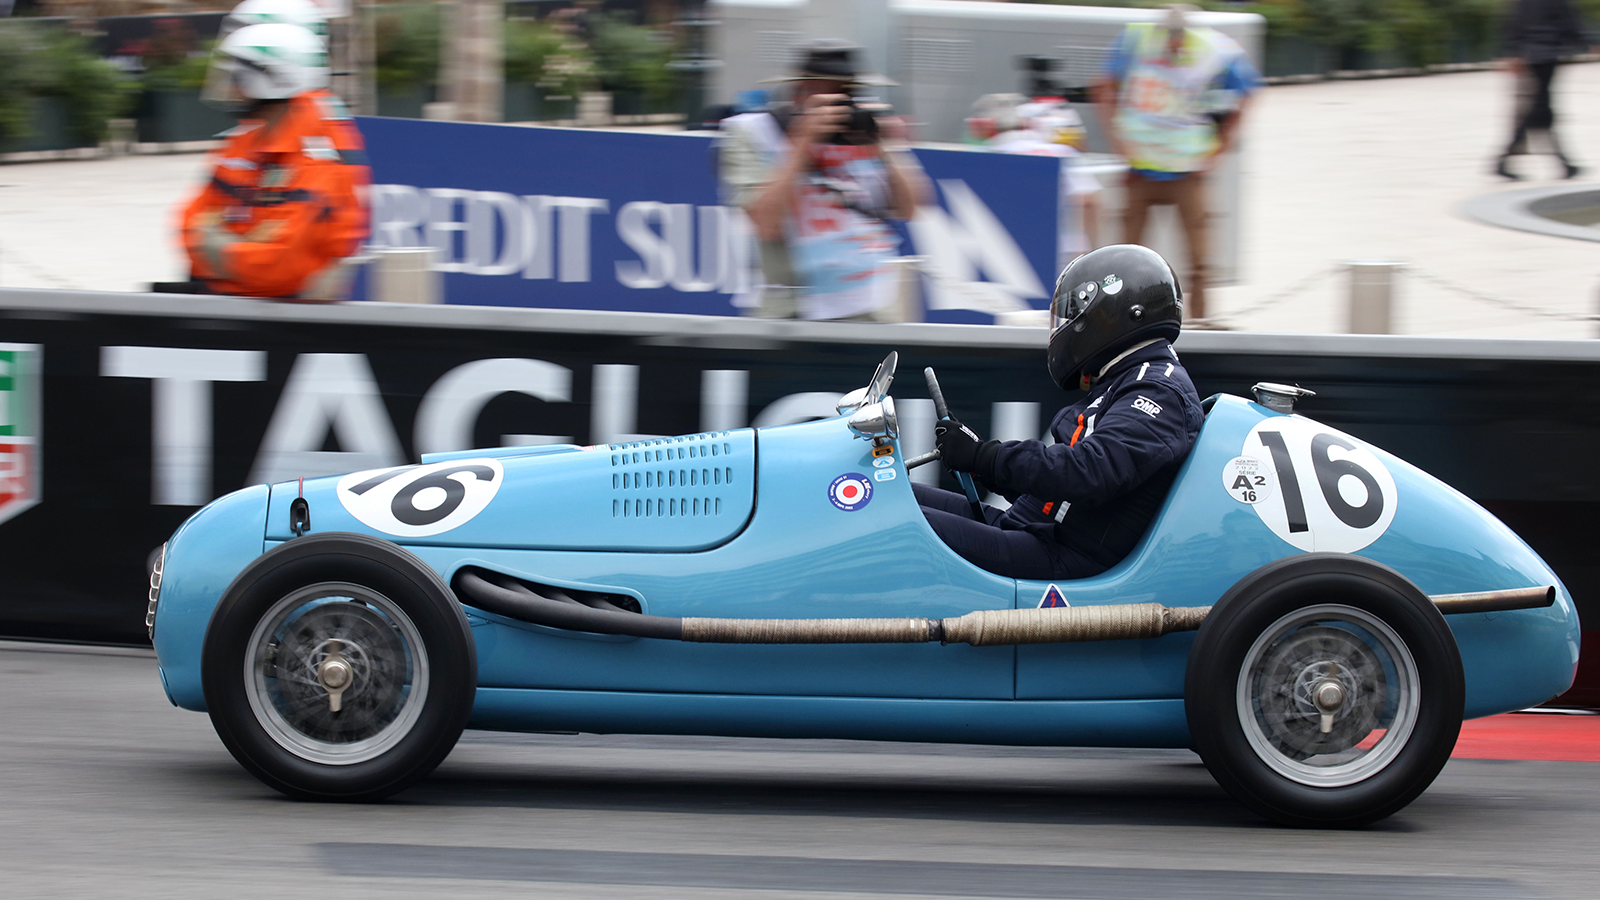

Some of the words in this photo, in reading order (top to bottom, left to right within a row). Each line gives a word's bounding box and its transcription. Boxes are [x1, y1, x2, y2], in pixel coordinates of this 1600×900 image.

[354, 184, 610, 284] REDIT
[1133, 398, 1161, 415] OMP
[347, 464, 496, 527] 16
[1241, 491, 1257, 502] 16
[1257, 431, 1385, 534] 16
